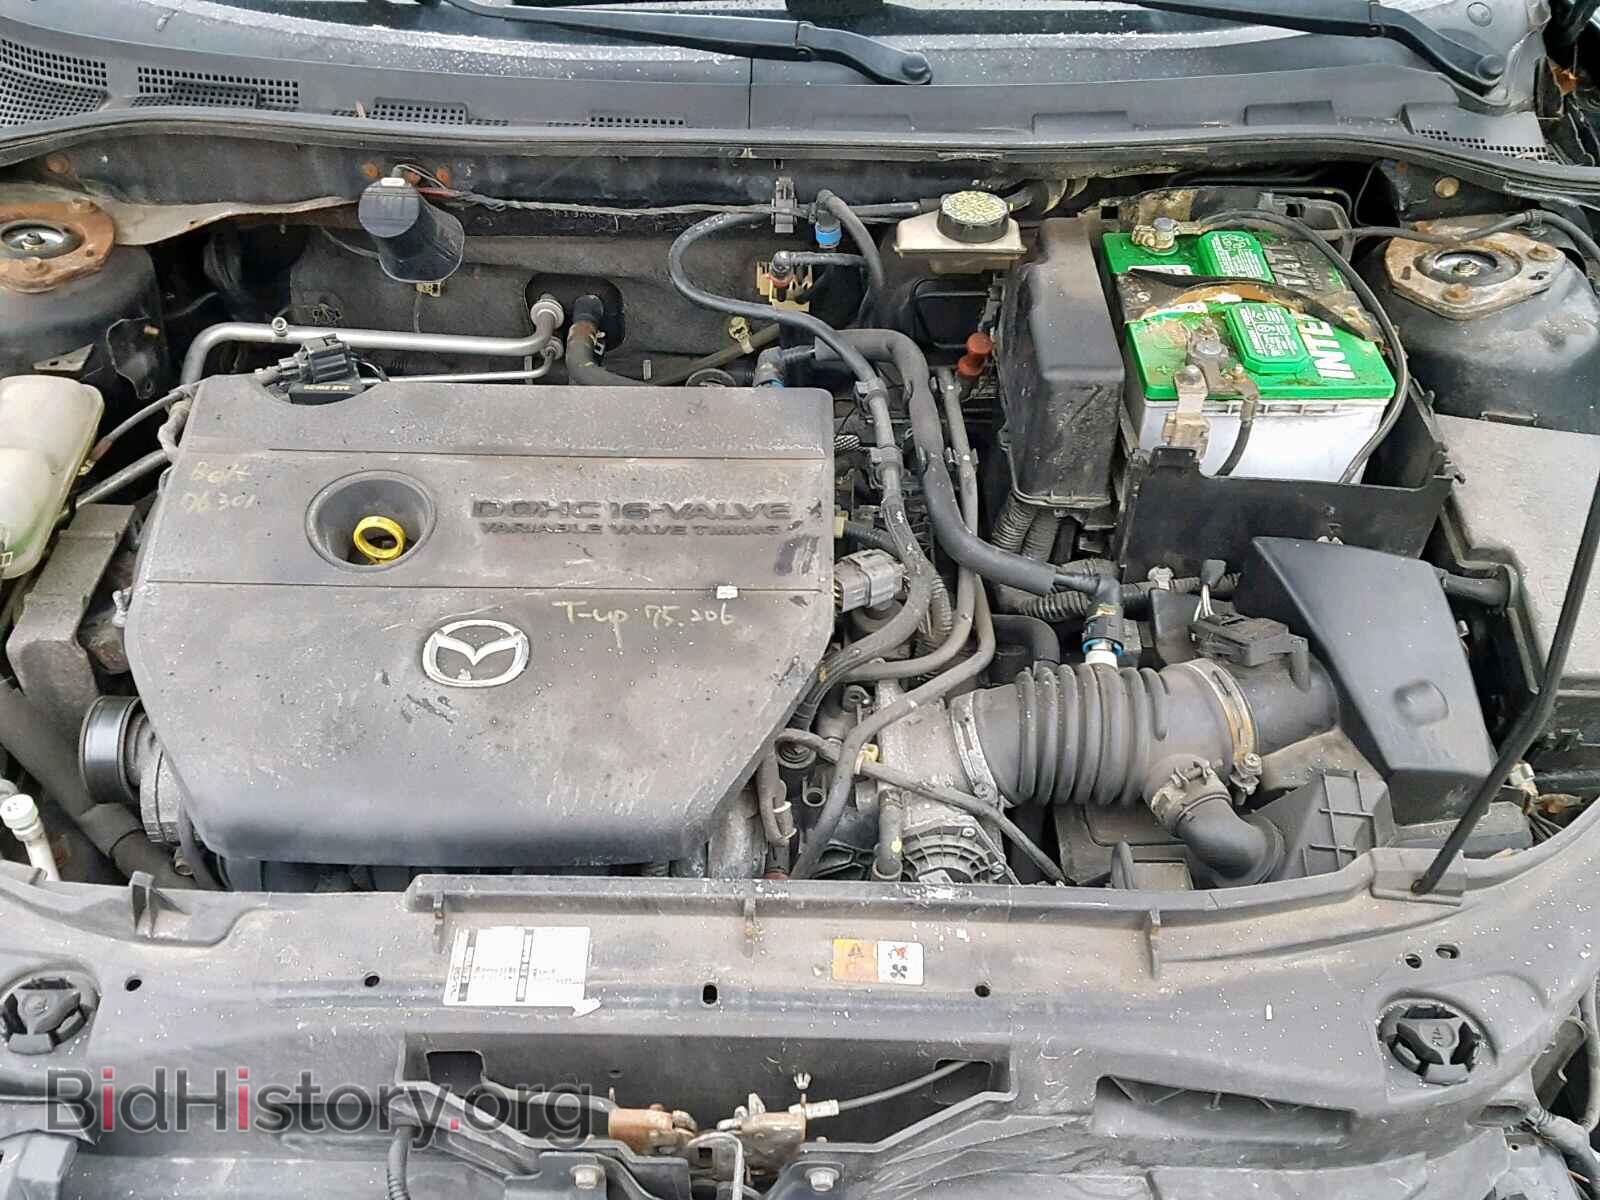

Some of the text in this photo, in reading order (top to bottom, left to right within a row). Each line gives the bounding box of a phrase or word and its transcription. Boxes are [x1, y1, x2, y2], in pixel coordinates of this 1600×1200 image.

[472, 501, 792, 520] DOHC 16-VALVE
[480, 521, 603, 535] VARIABLE
[609, 524, 688, 536] VALVE
